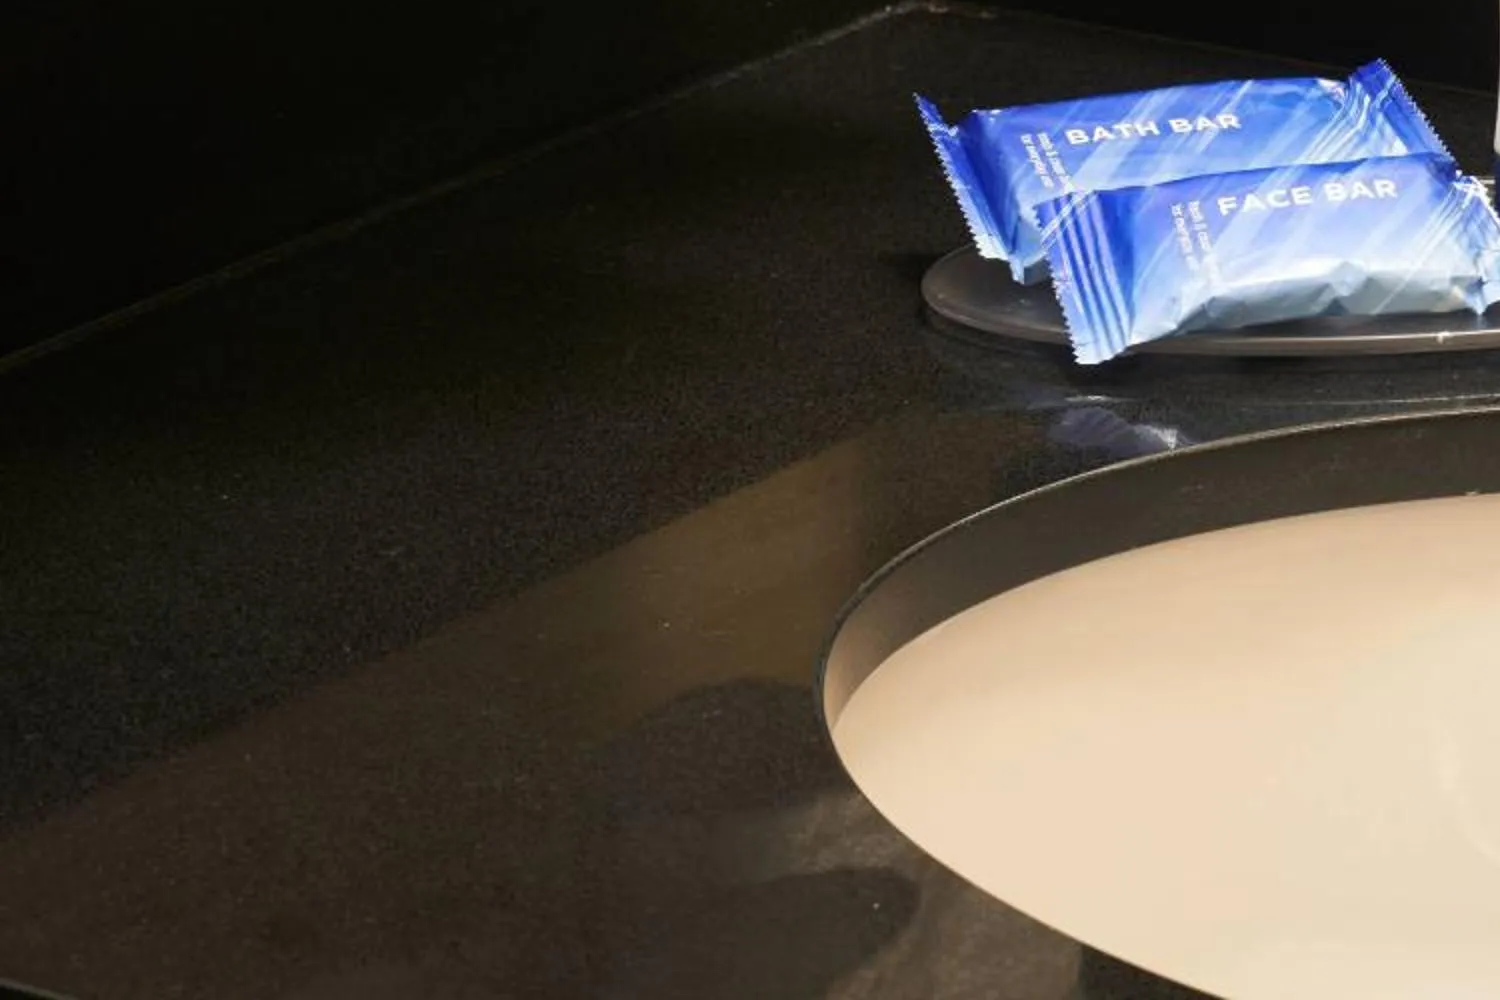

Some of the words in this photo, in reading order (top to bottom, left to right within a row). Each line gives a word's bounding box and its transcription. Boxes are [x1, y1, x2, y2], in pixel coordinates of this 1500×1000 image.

[1065, 120, 1161, 145] BATH
[1168, 112, 1242, 134] BAR
[1217, 185, 1314, 217] FACE
[1322, 178, 1398, 202] BAR
